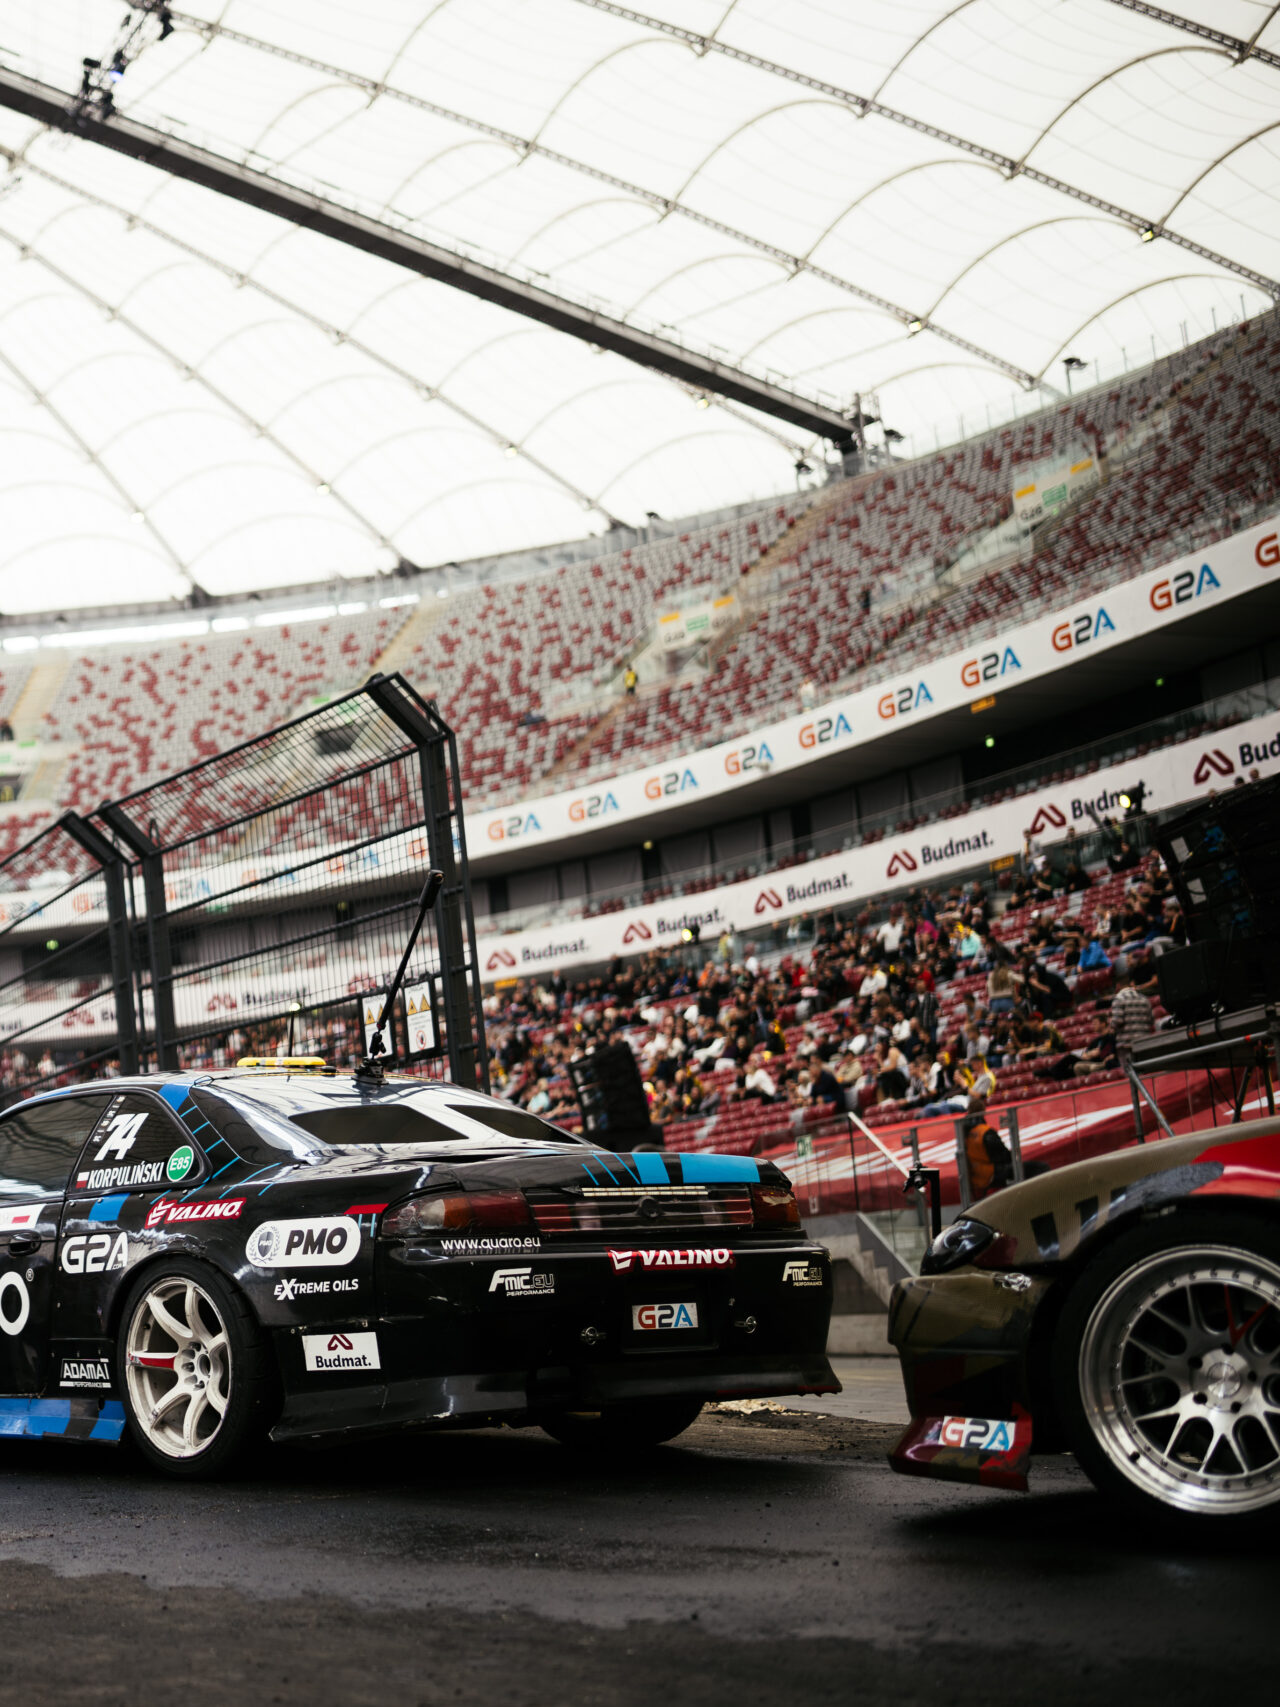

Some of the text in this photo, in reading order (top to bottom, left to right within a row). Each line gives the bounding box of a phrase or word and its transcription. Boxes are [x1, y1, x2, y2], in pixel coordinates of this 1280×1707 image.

[1149, 563, 1220, 612] G2A
[1052, 607, 1115, 653] G2A
[961, 646, 1021, 688] G2A
[877, 681, 933, 720] G2A
[799, 713, 852, 749] G2A
[725, 742, 774, 775] G2A
[645, 769, 698, 799] G2A
[568, 792, 619, 822] G2A
[487, 813, 541, 841] G2A
[921, 830, 995, 865] Budmat.
[787, 873, 854, 902] Budmat.
[522, 939, 591, 963] Budmat.
[87, 1161, 164, 1190] KORPULIŃSKI
[169, 1156, 191, 1171] E85
[166, 1201, 243, 1221] VALINO
[61, 1231, 128, 1274] G2A
[285, 1227, 347, 1255] PMO
[441, 1236, 541, 1250] www.quaro.eu
[638, 1248, 730, 1266] VALINO
[274, 1278, 359, 1301] EXTREME OILS
[506, 1288, 555, 1297] PERFORMANCE
[637, 1303, 694, 1329] G2A
[316, 1355, 372, 1369] Budmat.
[941, 1416, 1010, 1452] G2A
